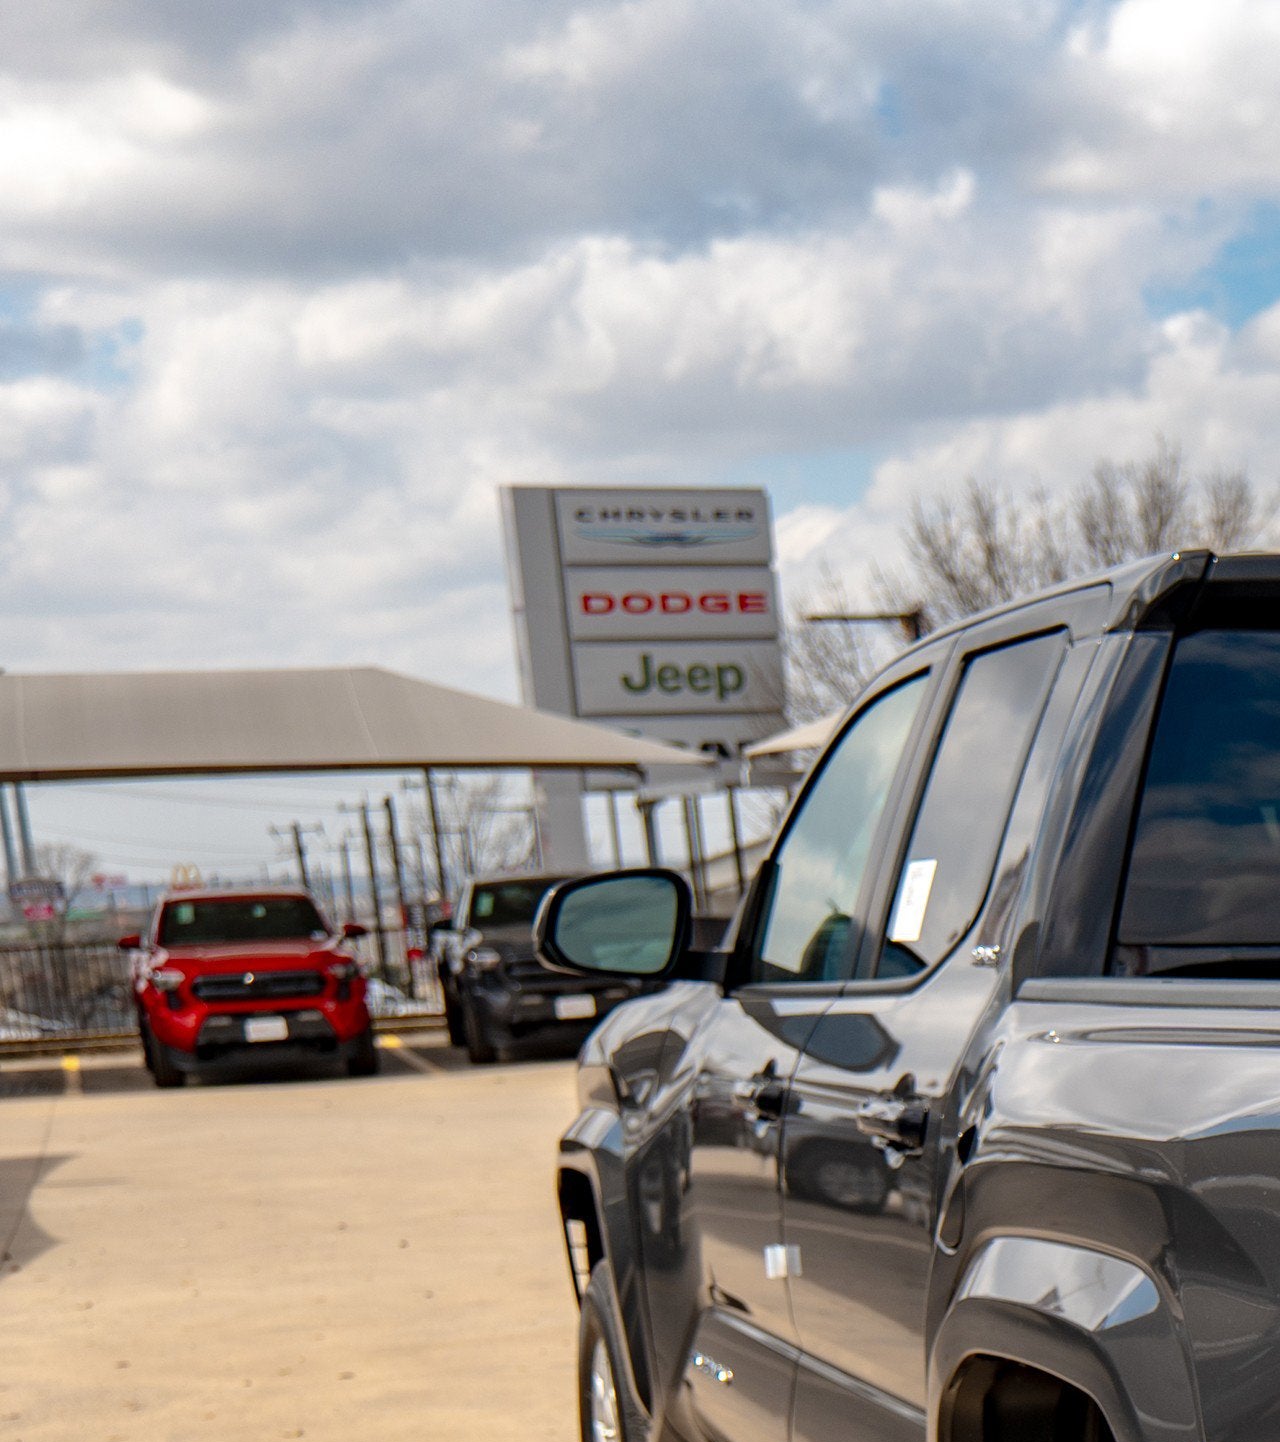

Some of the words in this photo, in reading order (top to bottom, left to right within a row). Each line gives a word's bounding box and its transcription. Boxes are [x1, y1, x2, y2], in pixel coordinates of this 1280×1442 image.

[575, 506, 754, 523] CHRYSLER
[582, 593, 768, 614] DODGE
[621, 654, 743, 700] Jeep
